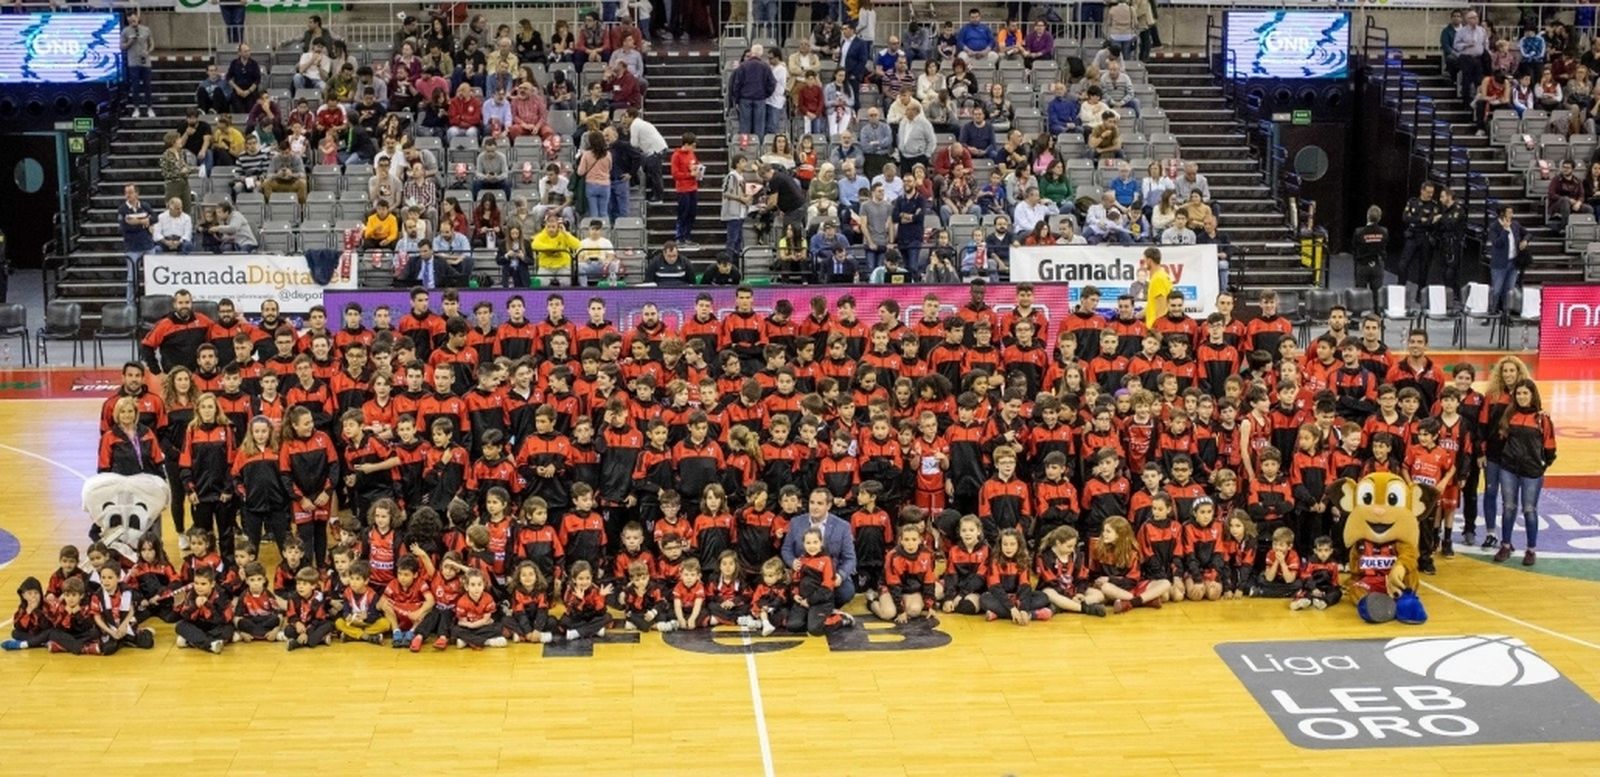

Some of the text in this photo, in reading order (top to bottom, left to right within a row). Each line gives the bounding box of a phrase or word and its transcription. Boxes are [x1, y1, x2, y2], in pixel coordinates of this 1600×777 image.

[1241, 654, 1360, 675] Liga
[1271, 686, 1466, 714] LEB
[1298, 714, 1480, 740] ORO
